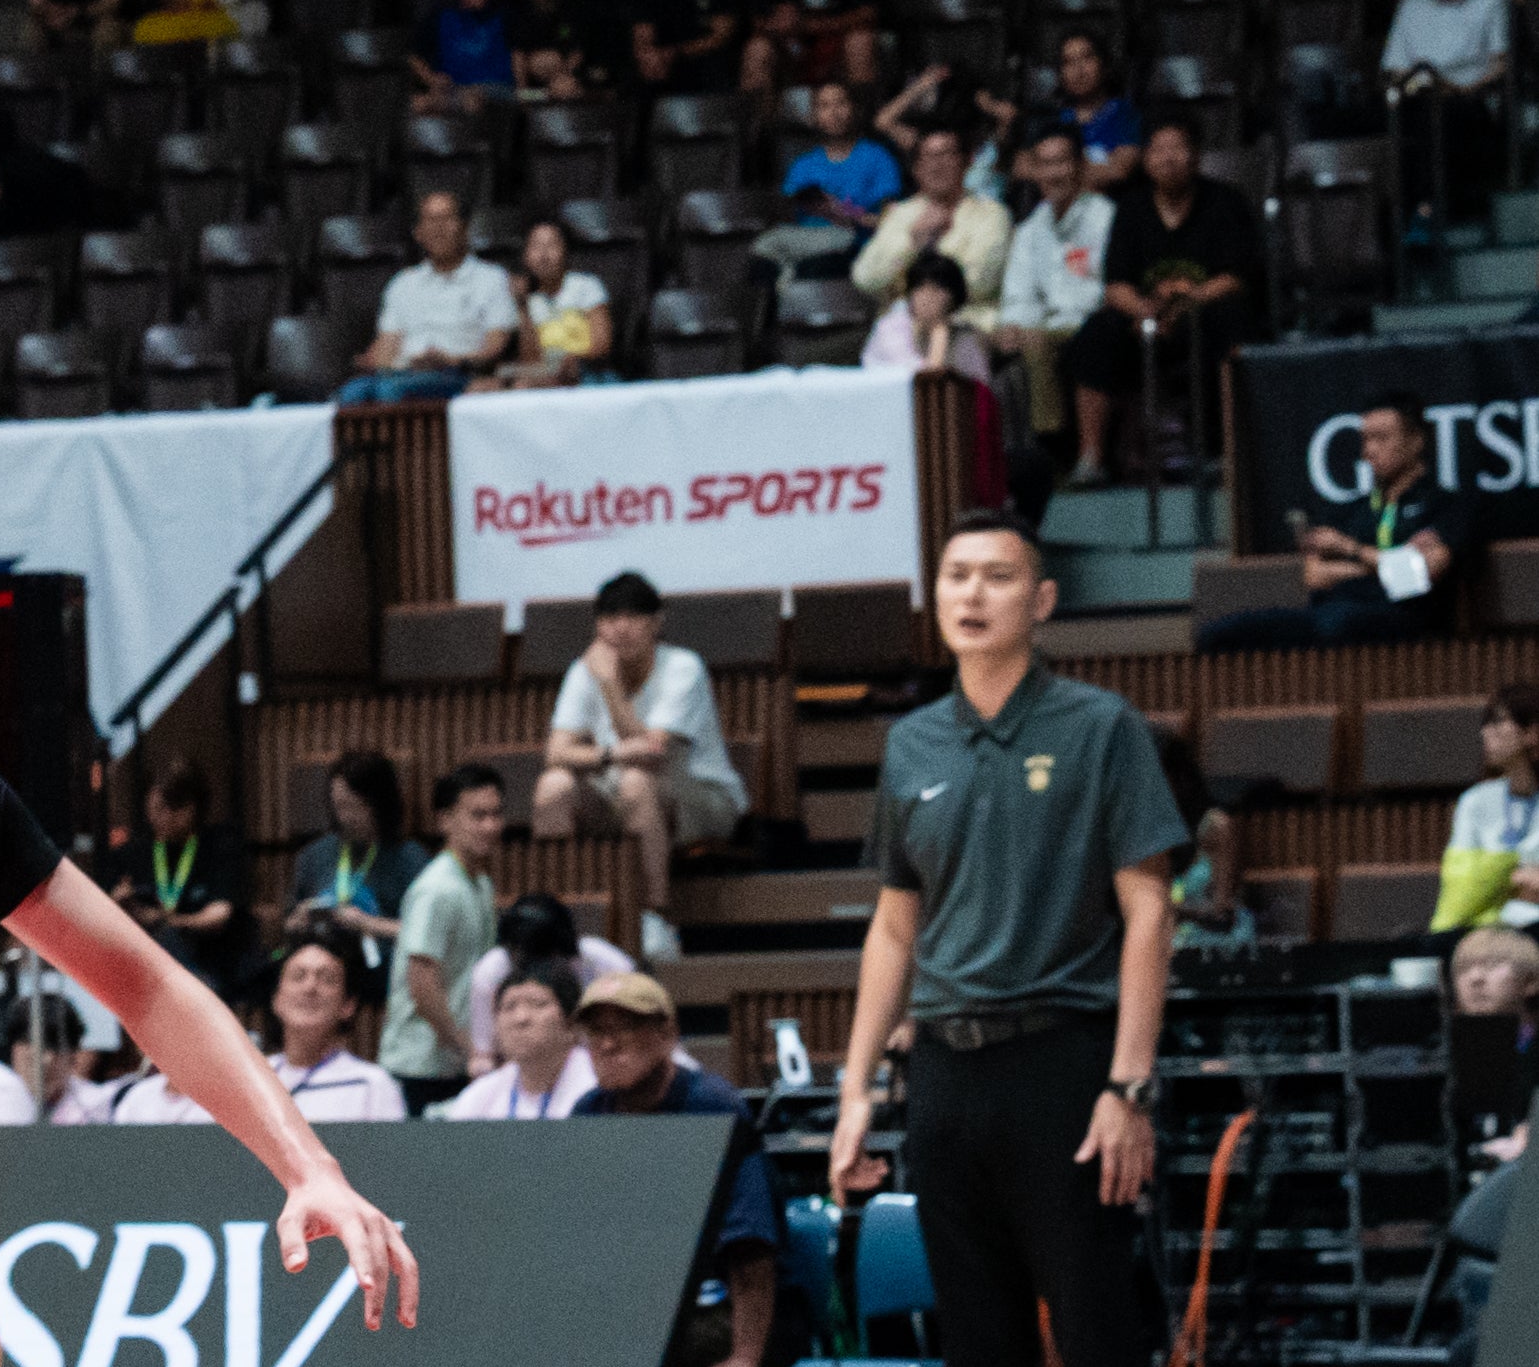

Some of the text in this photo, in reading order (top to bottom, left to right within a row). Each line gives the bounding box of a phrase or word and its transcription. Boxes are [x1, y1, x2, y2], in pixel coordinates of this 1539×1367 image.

[1308, 397, 1539, 503] GTS
[475, 464, 885, 533] Rakuten SPORTS
